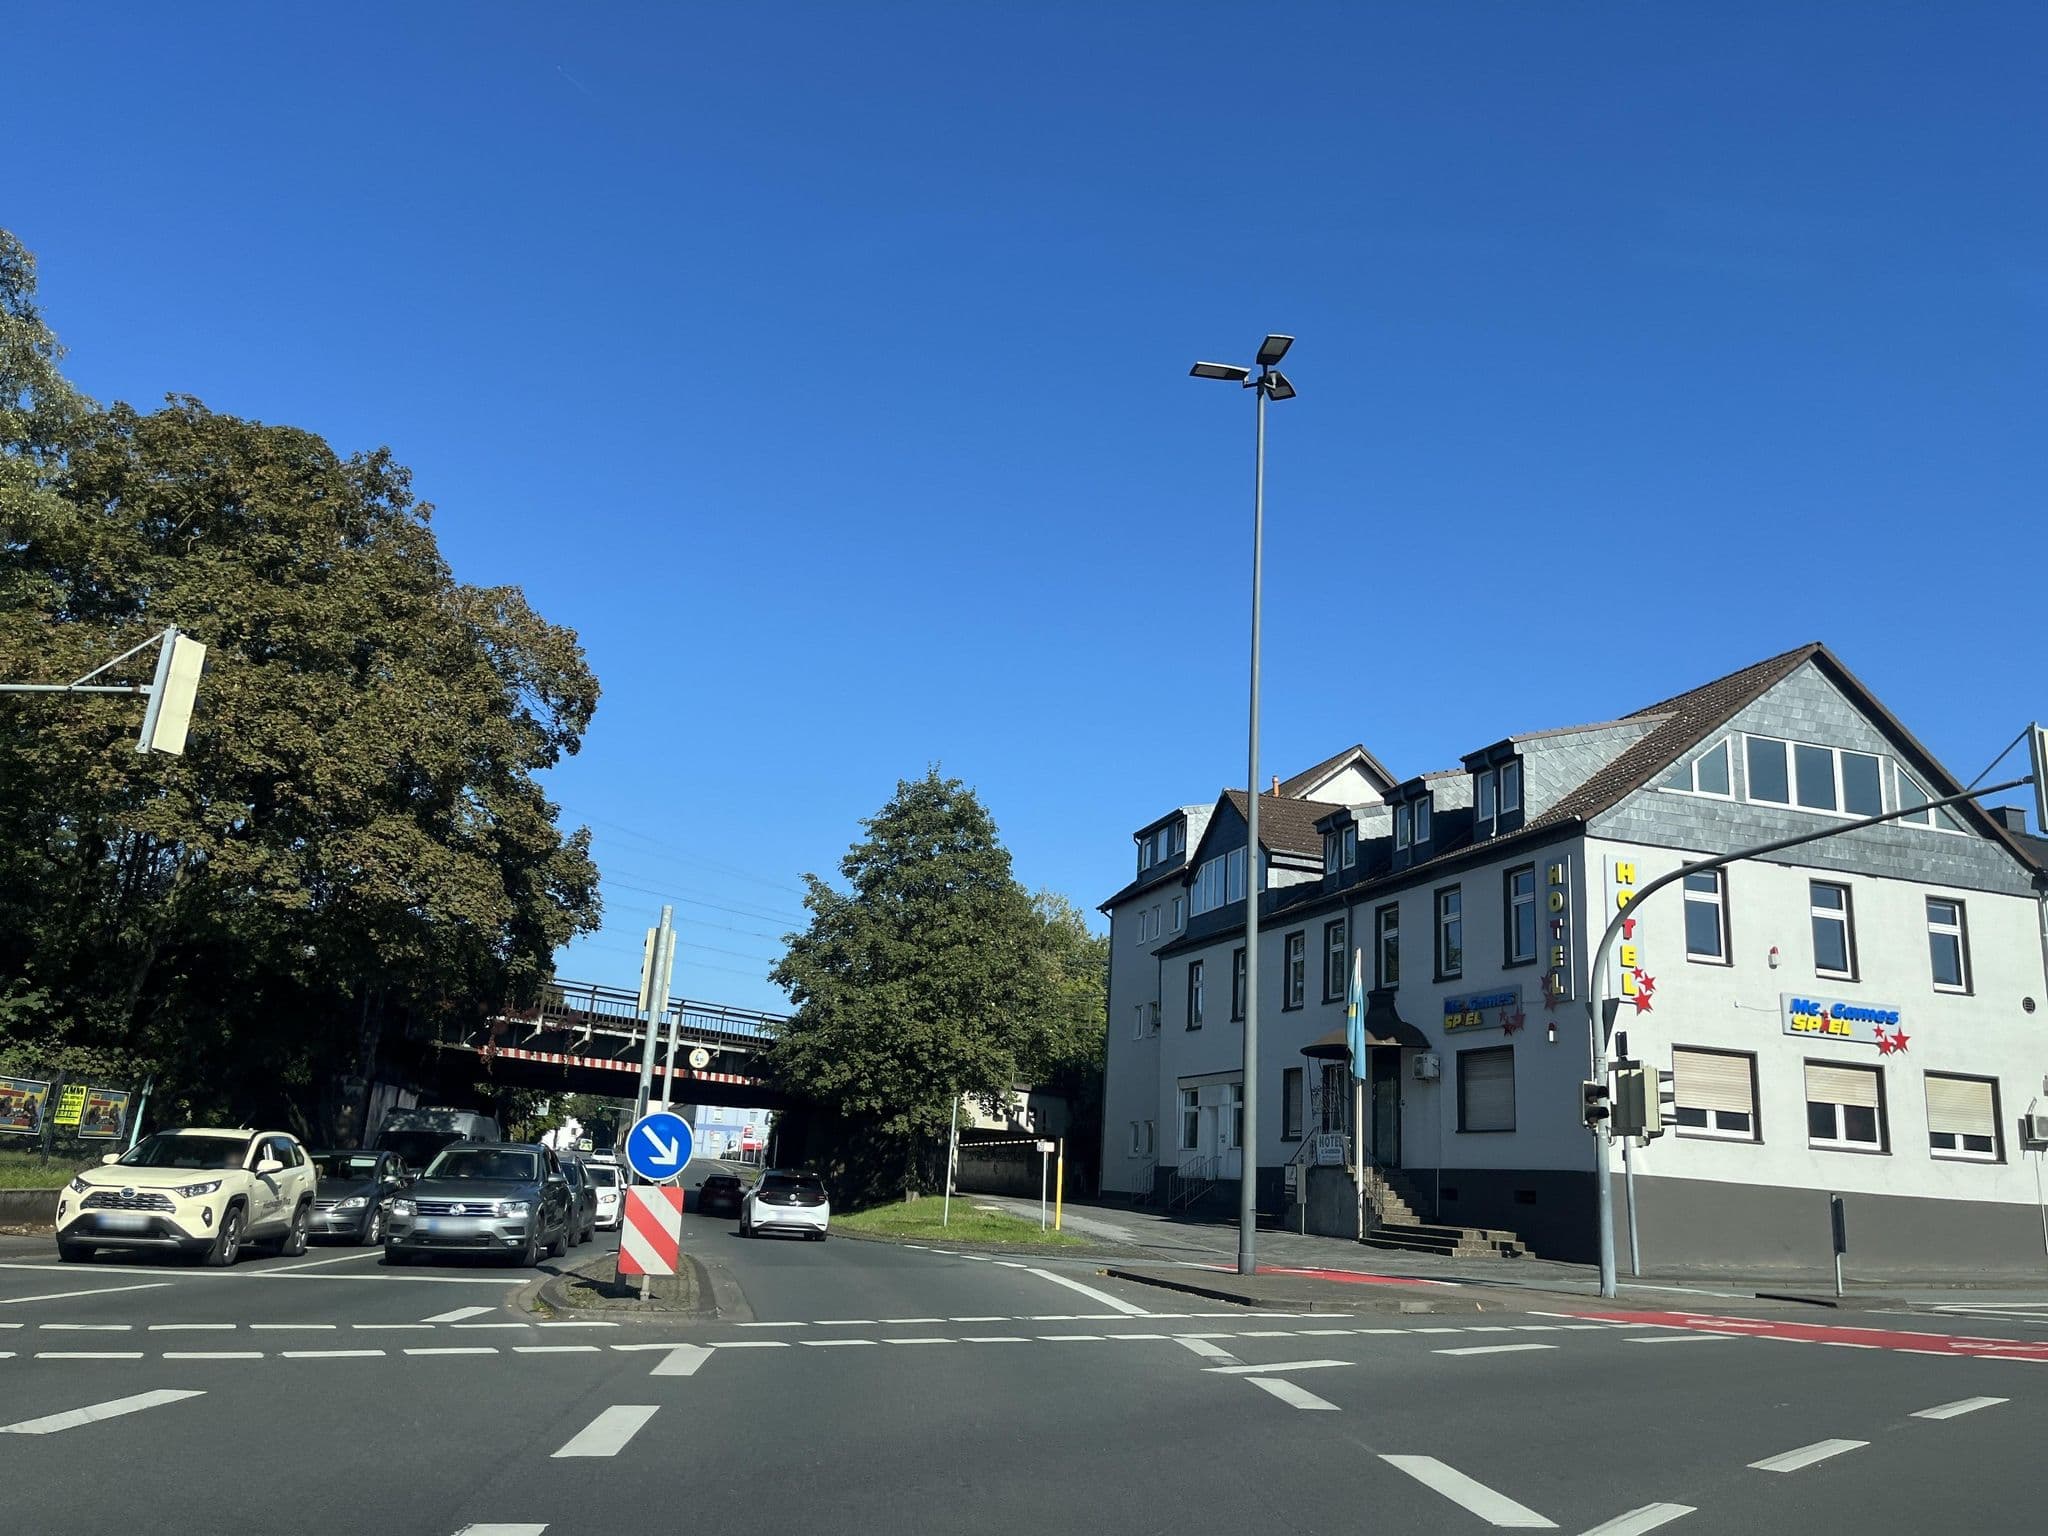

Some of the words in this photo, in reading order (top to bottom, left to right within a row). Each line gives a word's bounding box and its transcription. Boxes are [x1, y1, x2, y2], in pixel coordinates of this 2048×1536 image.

[1549, 863, 1565, 995] HOTEL
[1615, 862, 1639, 996] HOTEL
[1467, 992, 1515, 1011] Games
[1831, 1003, 1899, 1025] Games
[1319, 1135, 1343, 1148] HOTEL
